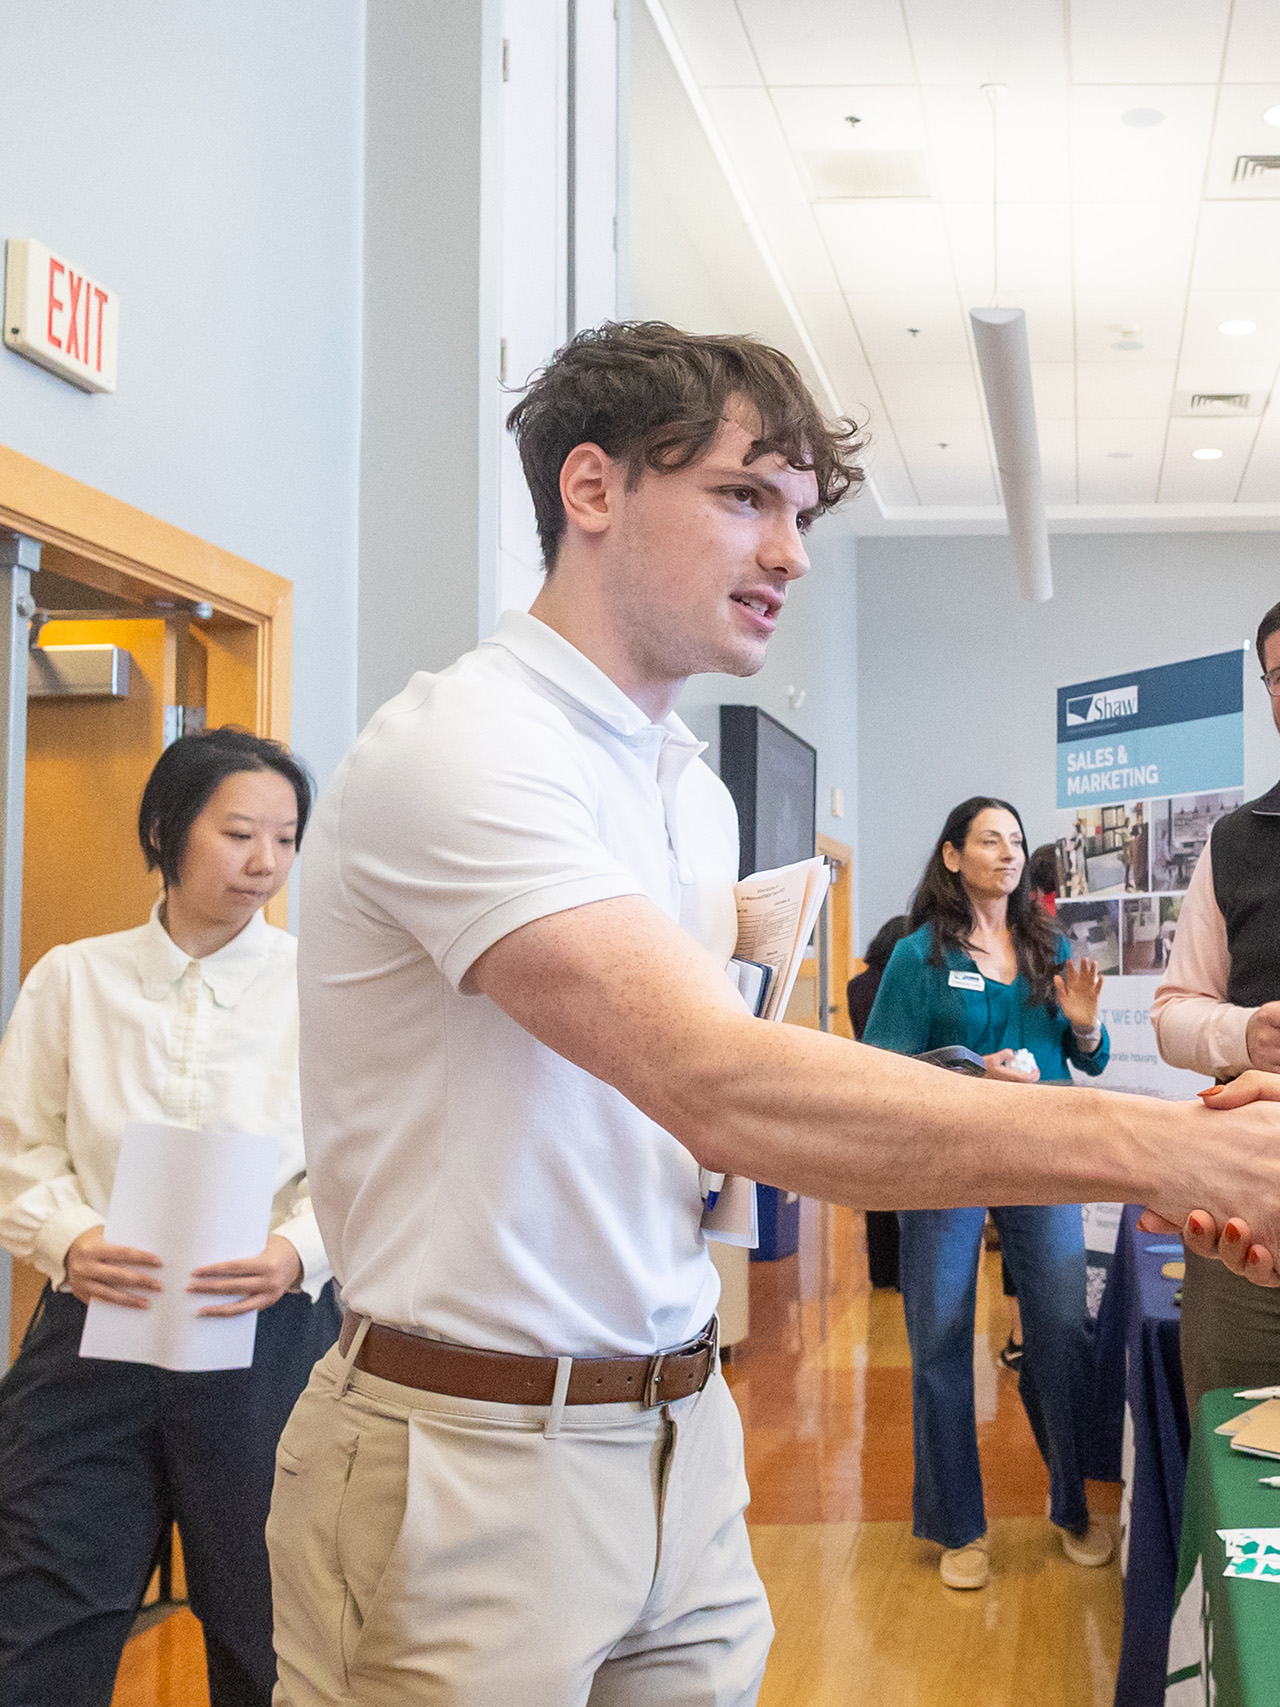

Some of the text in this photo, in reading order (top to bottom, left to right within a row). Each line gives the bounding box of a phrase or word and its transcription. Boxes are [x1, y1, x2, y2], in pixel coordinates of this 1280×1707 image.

[47, 257, 109, 373] EXIT
[1094, 696, 1136, 720] Shaw
[1067, 744, 1129, 772] SALES &
[1067, 763, 1159, 796] MARKETING
[1112, 1008, 1130, 1025] WE
